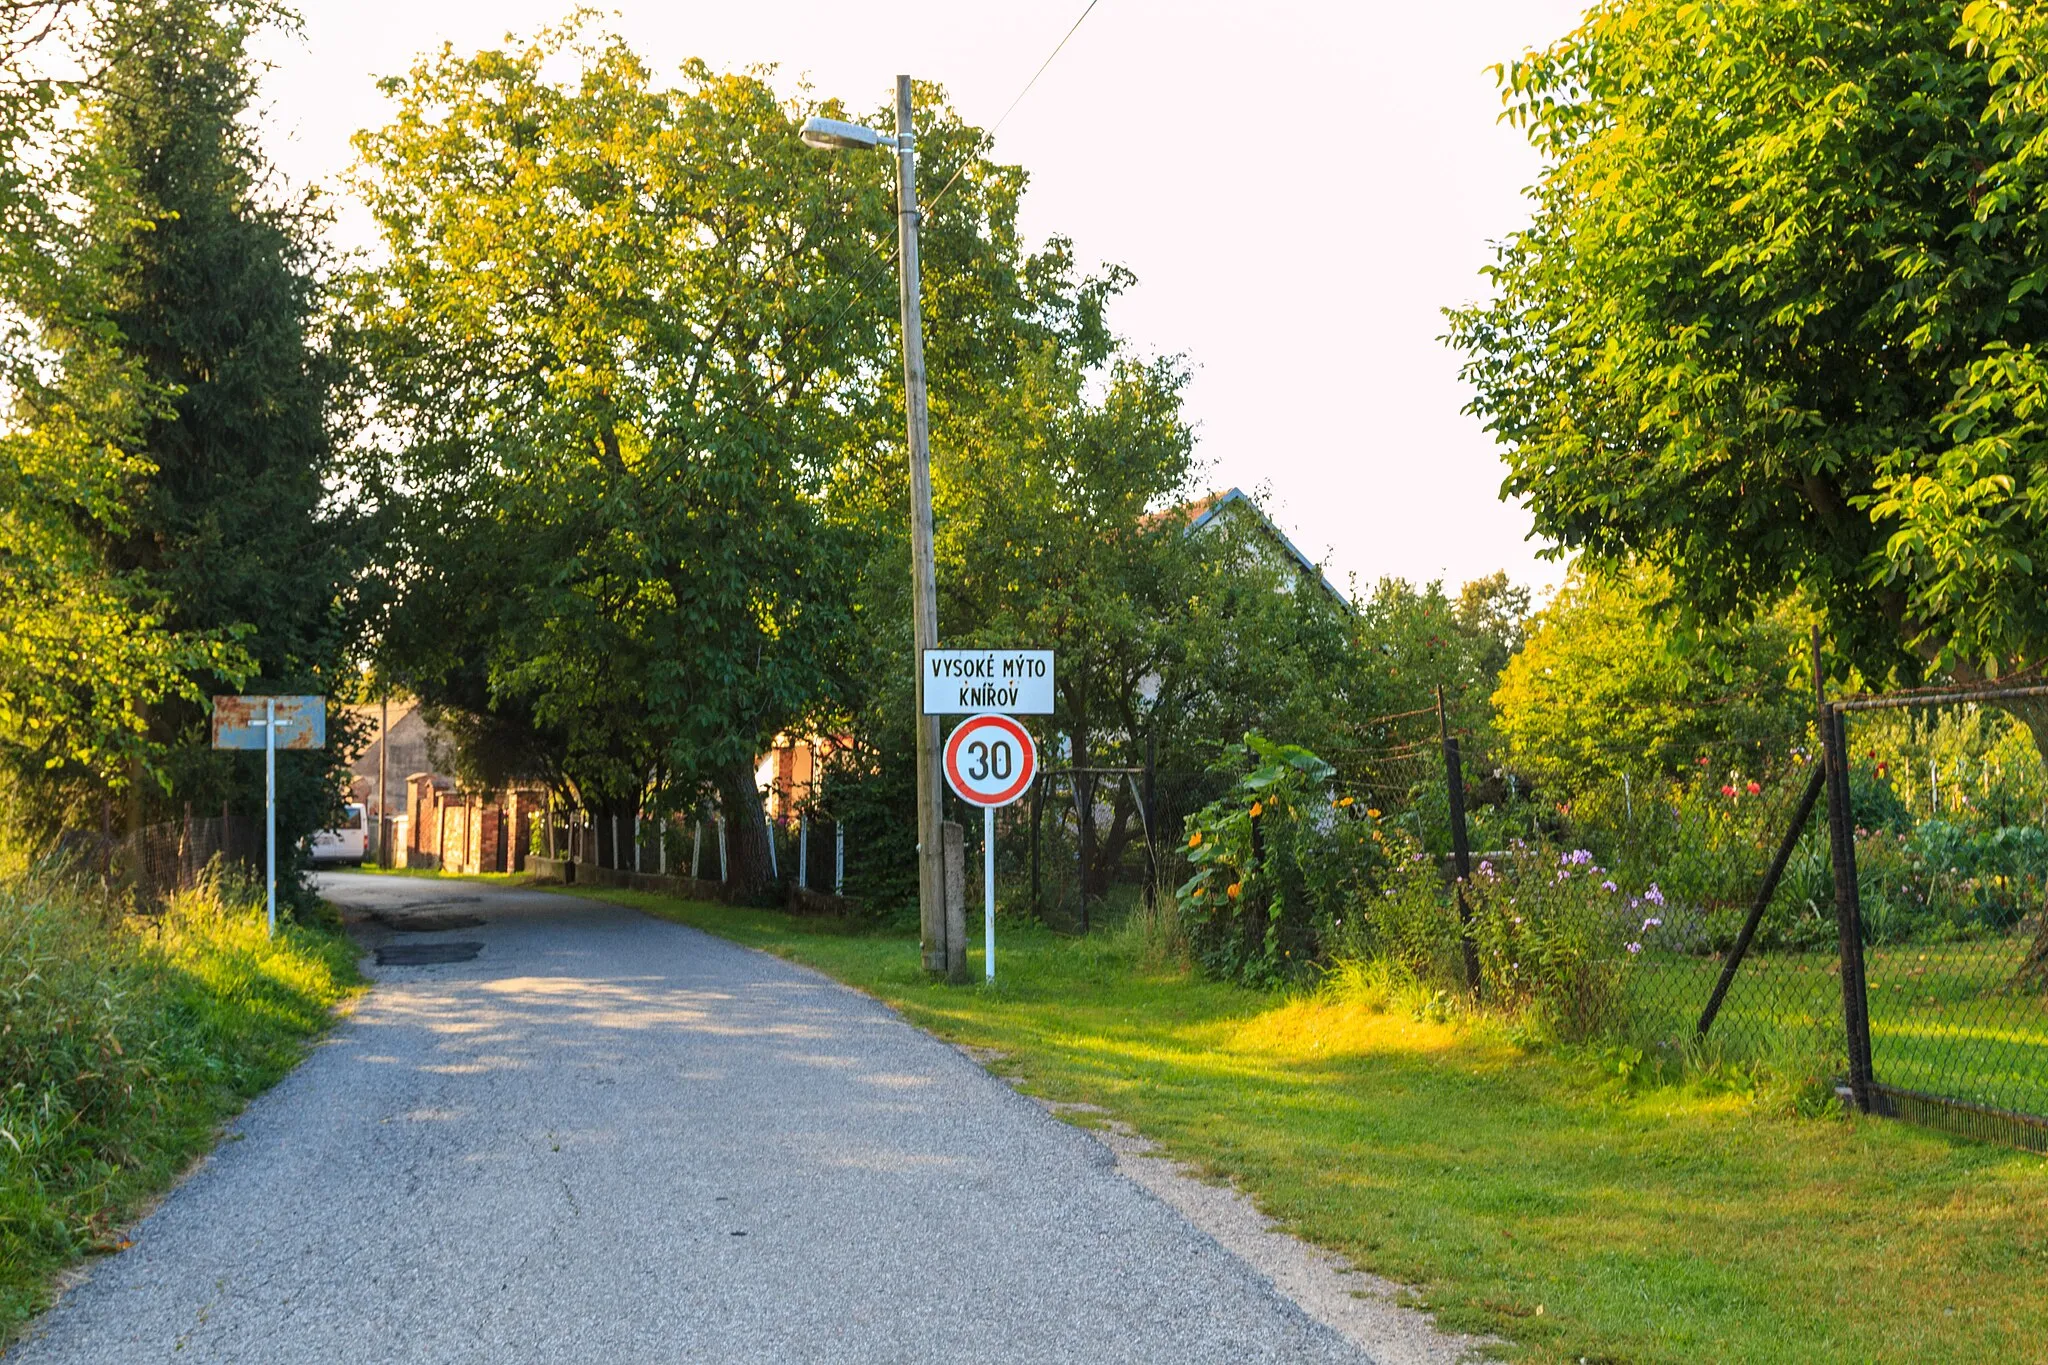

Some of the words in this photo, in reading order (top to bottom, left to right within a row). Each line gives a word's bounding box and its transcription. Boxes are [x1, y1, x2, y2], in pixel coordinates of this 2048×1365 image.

[932, 654, 995, 678] VYSOKÉ
[1003, 654, 1046, 678] MÝTO
[959, 682, 1019, 706] KNÍŘOV
[968, 741, 1012, 781] 30
